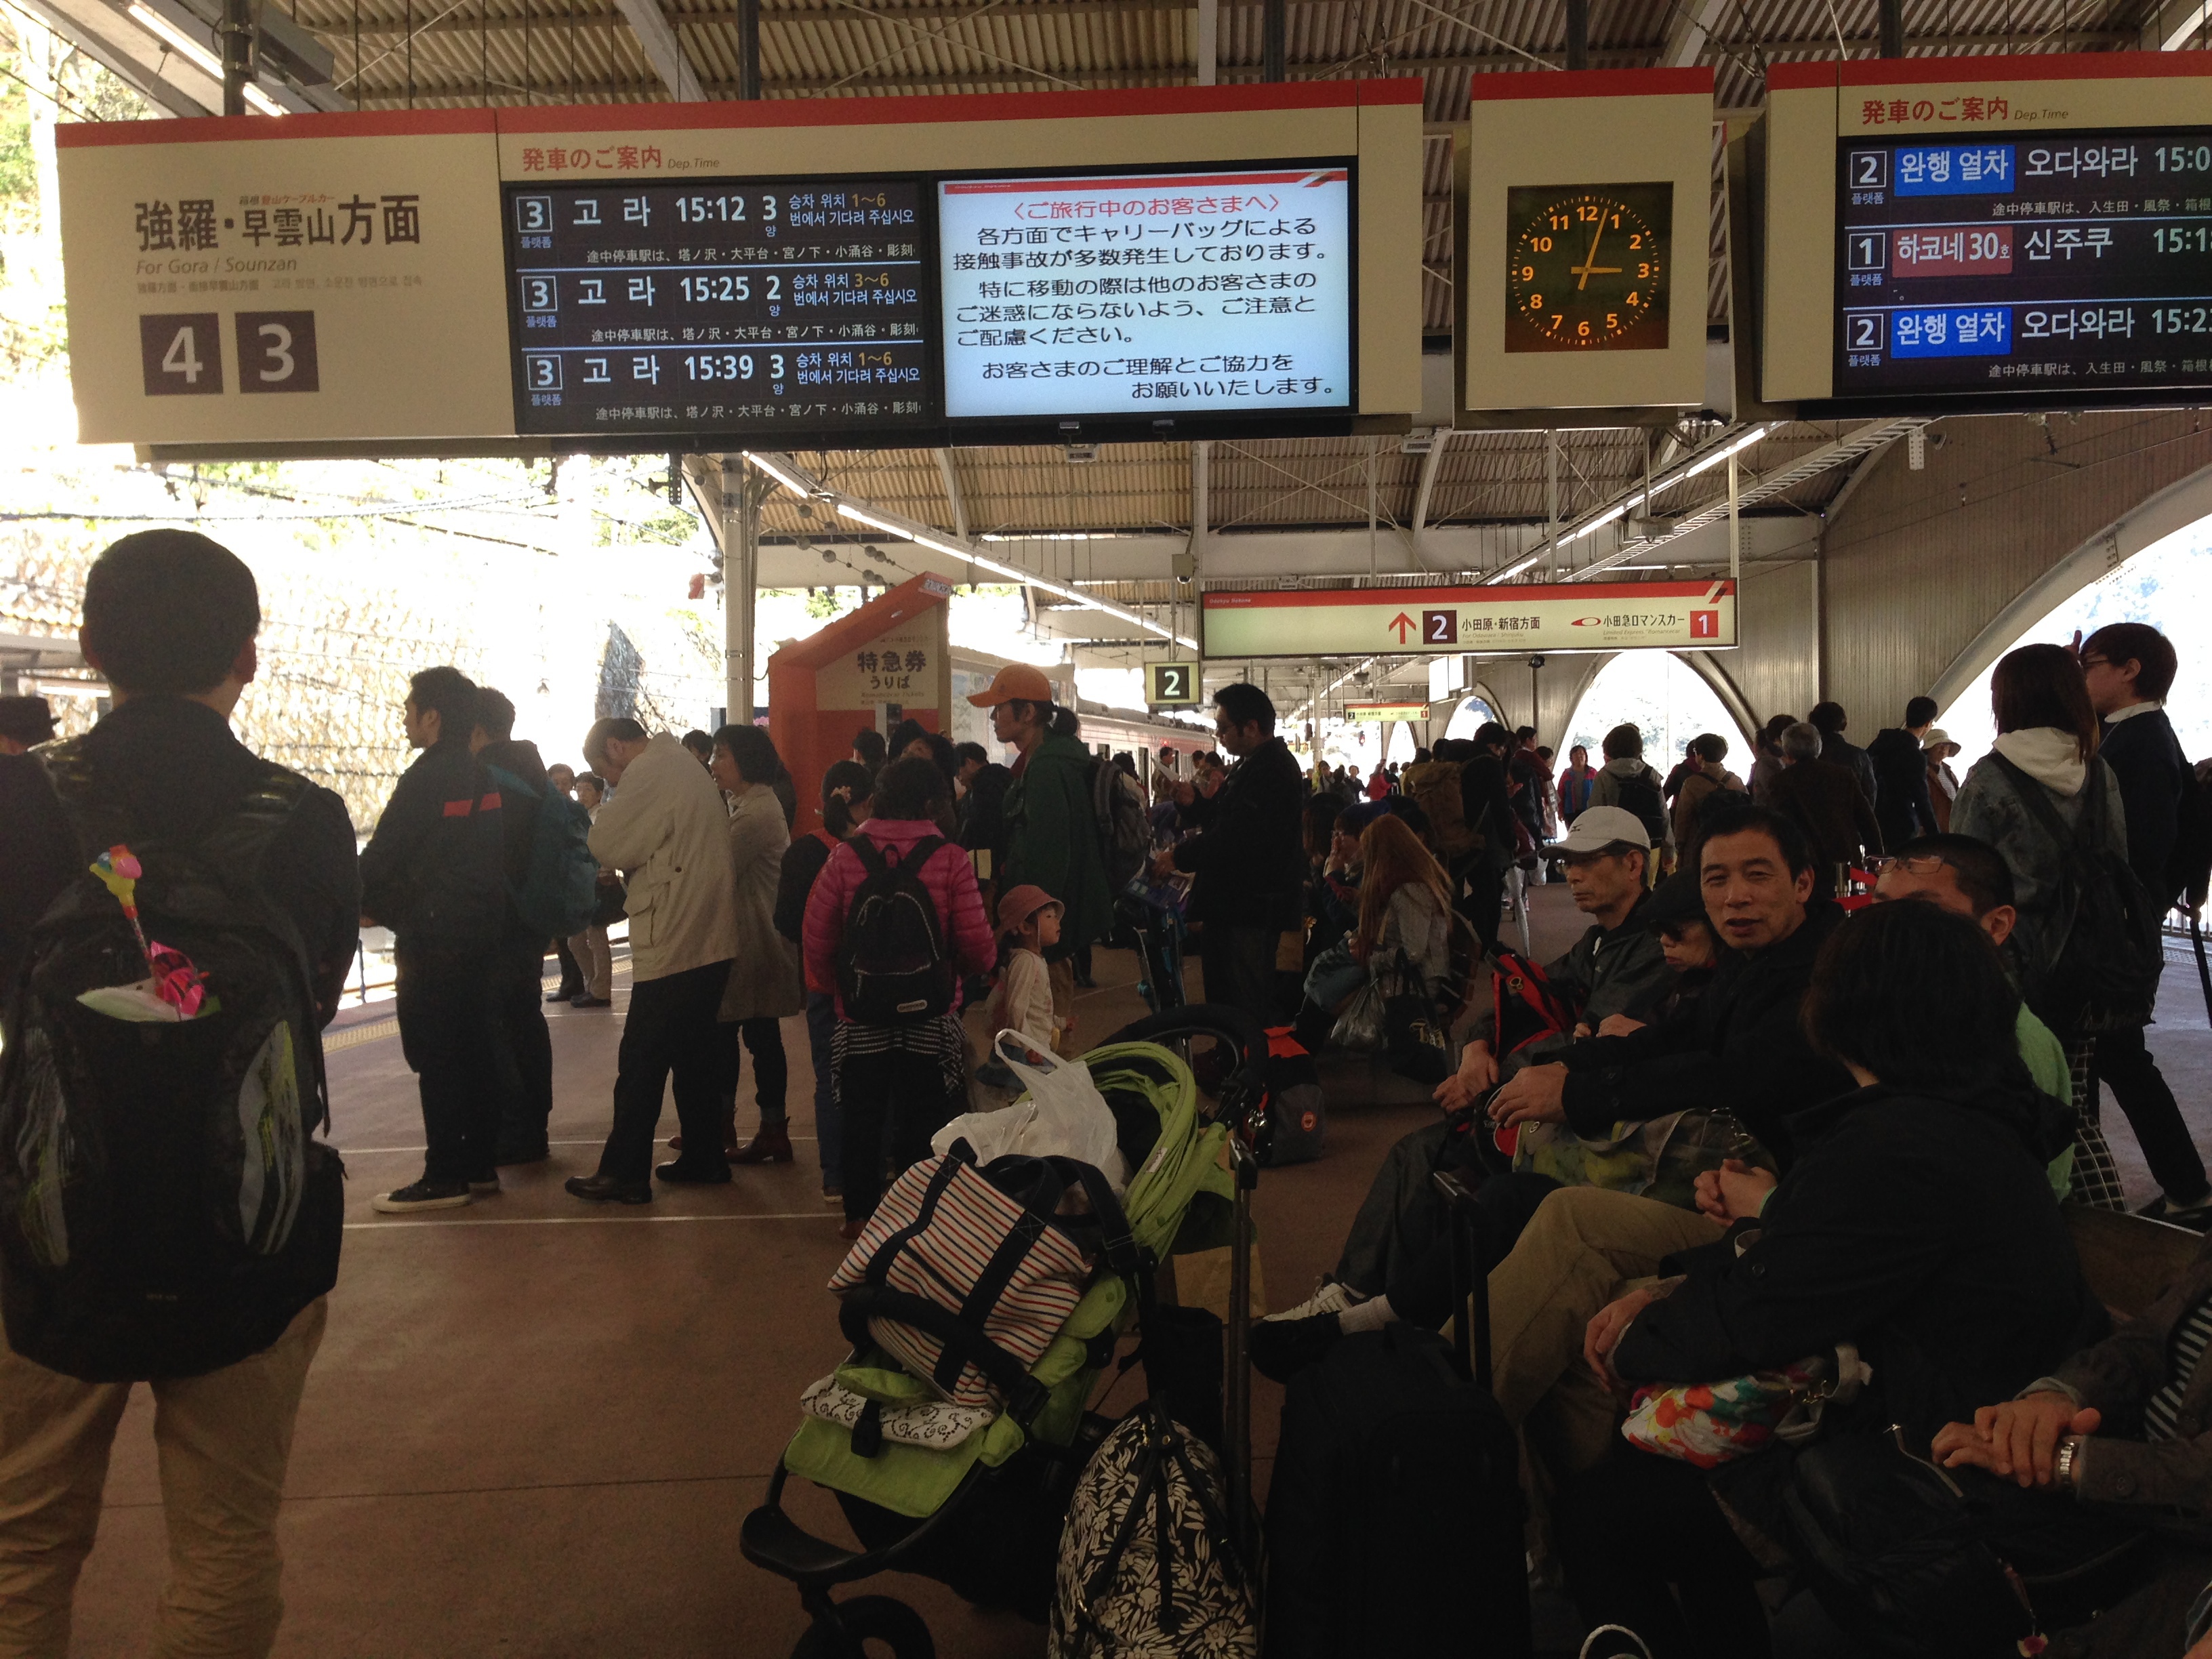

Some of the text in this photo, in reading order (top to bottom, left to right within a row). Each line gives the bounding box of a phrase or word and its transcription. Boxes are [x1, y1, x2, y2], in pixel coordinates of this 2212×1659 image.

[1862, 96, 2009, 125] 発車のご案内
[521, 145, 662, 172] 発車のご案内
[1860, 156, 1878, 184] 2
[1900, 150, 1951, 184] 완행
[1959, 148, 2009, 182] 열차
[2025, 145, 2139, 179] 오다와라
[789, 193, 815, 210] 승차
[820, 192, 846, 209] 위치
[526, 201, 543, 228] 3
[675, 196, 746, 222] 15:12
[762, 195, 777, 221] 3
[790, 209, 915, 227] 번에서 기다려 주십시오
[1576, 205, 1598, 222] 12
[1611, 213, 1620, 229] 1
[135, 194, 421, 252] 強羅・早雲山方面
[765, 225, 777, 237] 양
[977, 218, 1317, 245] 各方面でキャリーバッグによる
[1550, 216, 1569, 230] 11
[1530, 237, 1552, 253] 10
[1629, 234, 1641, 249] 2
[1859, 237, 1872, 265] 1
[1898, 231, 1964, 264] 하코네
[2024, 226, 2114, 261] 신주쿠
[2153, 228, 2212, 253] 15:1
[586, 243, 915, 264] 途中停車駅は、塔ノ沢・大平台・宮ノ下・小涌谷・彫刻
[952, 242, 1326, 270] 接触事故が多数発生しております。
[136, 260, 163, 274] For
[168, 258, 209, 274] Gora
[225, 256, 298, 272] Sounzan
[1521, 266, 1534, 281] 9
[1637, 263, 1650, 279] 3
[531, 281, 548, 307] 3
[680, 275, 750, 303] 15:25
[766, 275, 781, 301] 2
[792, 273, 818, 290] 승차
[824, 272, 849, 289] 위치
[979, 272, 1317, 298] 特に移動の際は他のお客さまの
[793, 287, 918, 306] 번에서 기다려 주십시오
[1530, 293, 1542, 310] 8
[1626, 291, 1639, 307] 4
[769, 303, 781, 317] 양
[956, 296, 1315, 323] ご迷惑にならないよう、ご注意と
[1551, 314, 1563, 330] 7
[1578, 321, 1590, 336] 6
[1606, 313, 1618, 329] 5
[1856, 307, 2212, 346] 2 완행 열차 오다와라 15:2
[591, 323, 919, 343] 途中停車駅は、塔ノ沢・大平台・宮ノ下・小涌谷・彫刻
[956, 327, 1132, 347] ご配慮ください。
[161, 323, 295, 384] 4 3
[796, 352, 822, 369] 승차
[827, 352, 853, 368] 위치
[536, 359, 553, 386] 3
[684, 354, 754, 382] 15:39
[769, 354, 784, 380] 3
[796, 367, 920, 385] 번에서 기다려 주십시오
[982, 353, 1294, 379] お客さまのご理解とご協力を
[1988, 359, 2212, 379] 途中停車駅は、入生田・風祭・箱根
[773, 382, 784, 396] 양
[1131, 377, 1334, 400] お願いいたします。
[595, 402, 921, 422] 途中停車駅は、塔ノ沢・大平台・宮ノ下・小涌谷・彫刻
[1431, 615, 1540, 640] 2 小田原・新宿方面
[1603, 614, 1708, 634] 小田急ロマンスカー 1
[857, 650, 927, 673] 特急券
[870, 674, 911, 690] うりば
[1164, 671, 1181, 697] 2
